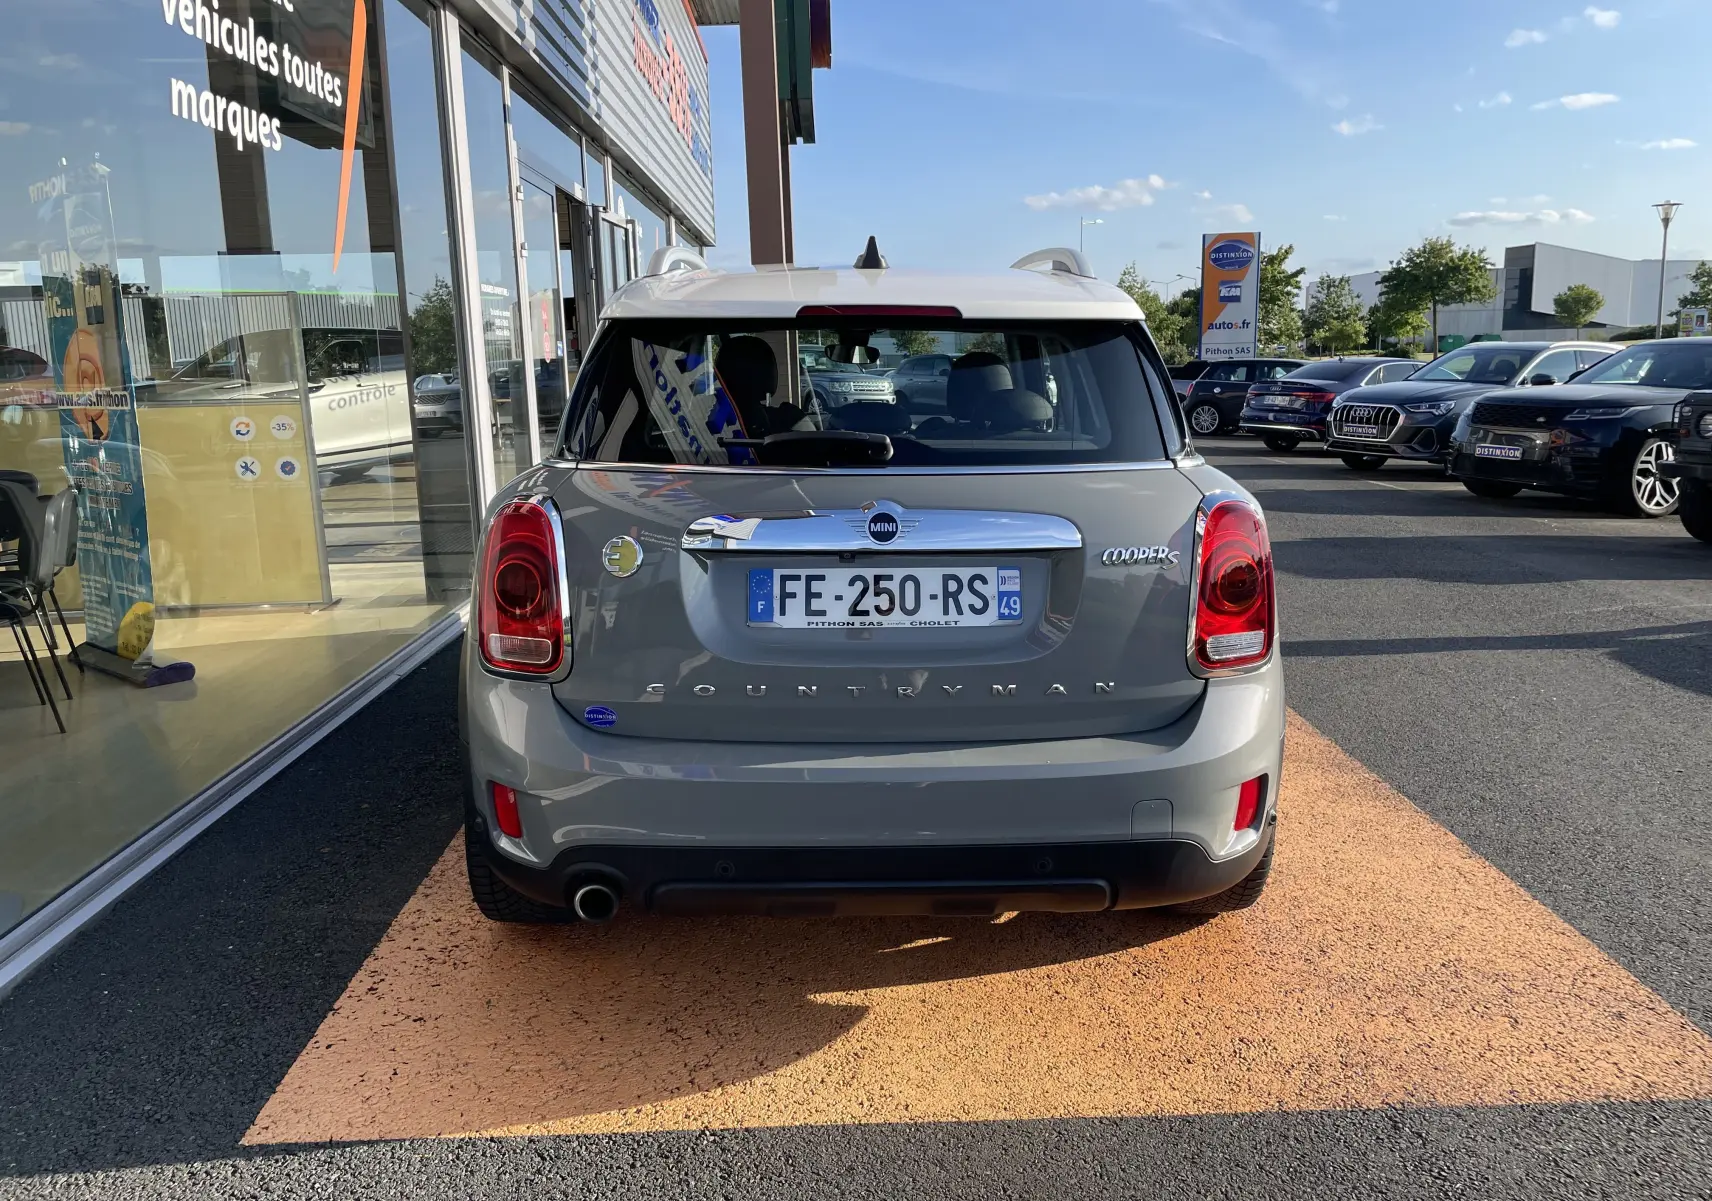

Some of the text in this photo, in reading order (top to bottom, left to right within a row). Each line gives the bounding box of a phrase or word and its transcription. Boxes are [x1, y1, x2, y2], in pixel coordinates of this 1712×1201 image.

[283, 43, 342, 107] toutes
[171, 78, 282, 151] marques
[1211, 250, 1252, 259] DISTINXION
[1208, 319, 1251, 330] autos.fr
[1205, 346, 1251, 355] Pithon SAS
[328, 382, 396, 411] contrôle
[272, 423, 294, 431] -35%
[1343, 426, 1377, 434] DISTINXION
[1476, 447, 1520, 457] DISTINXION
[870, 522, 897, 532] MINI
[779, 573, 990, 617] FE-250-RS
[757, 601, 765, 613] F
[1000, 596, 1020, 615] 49
[646, 682, 1116, 698] COUNTRYMAN
